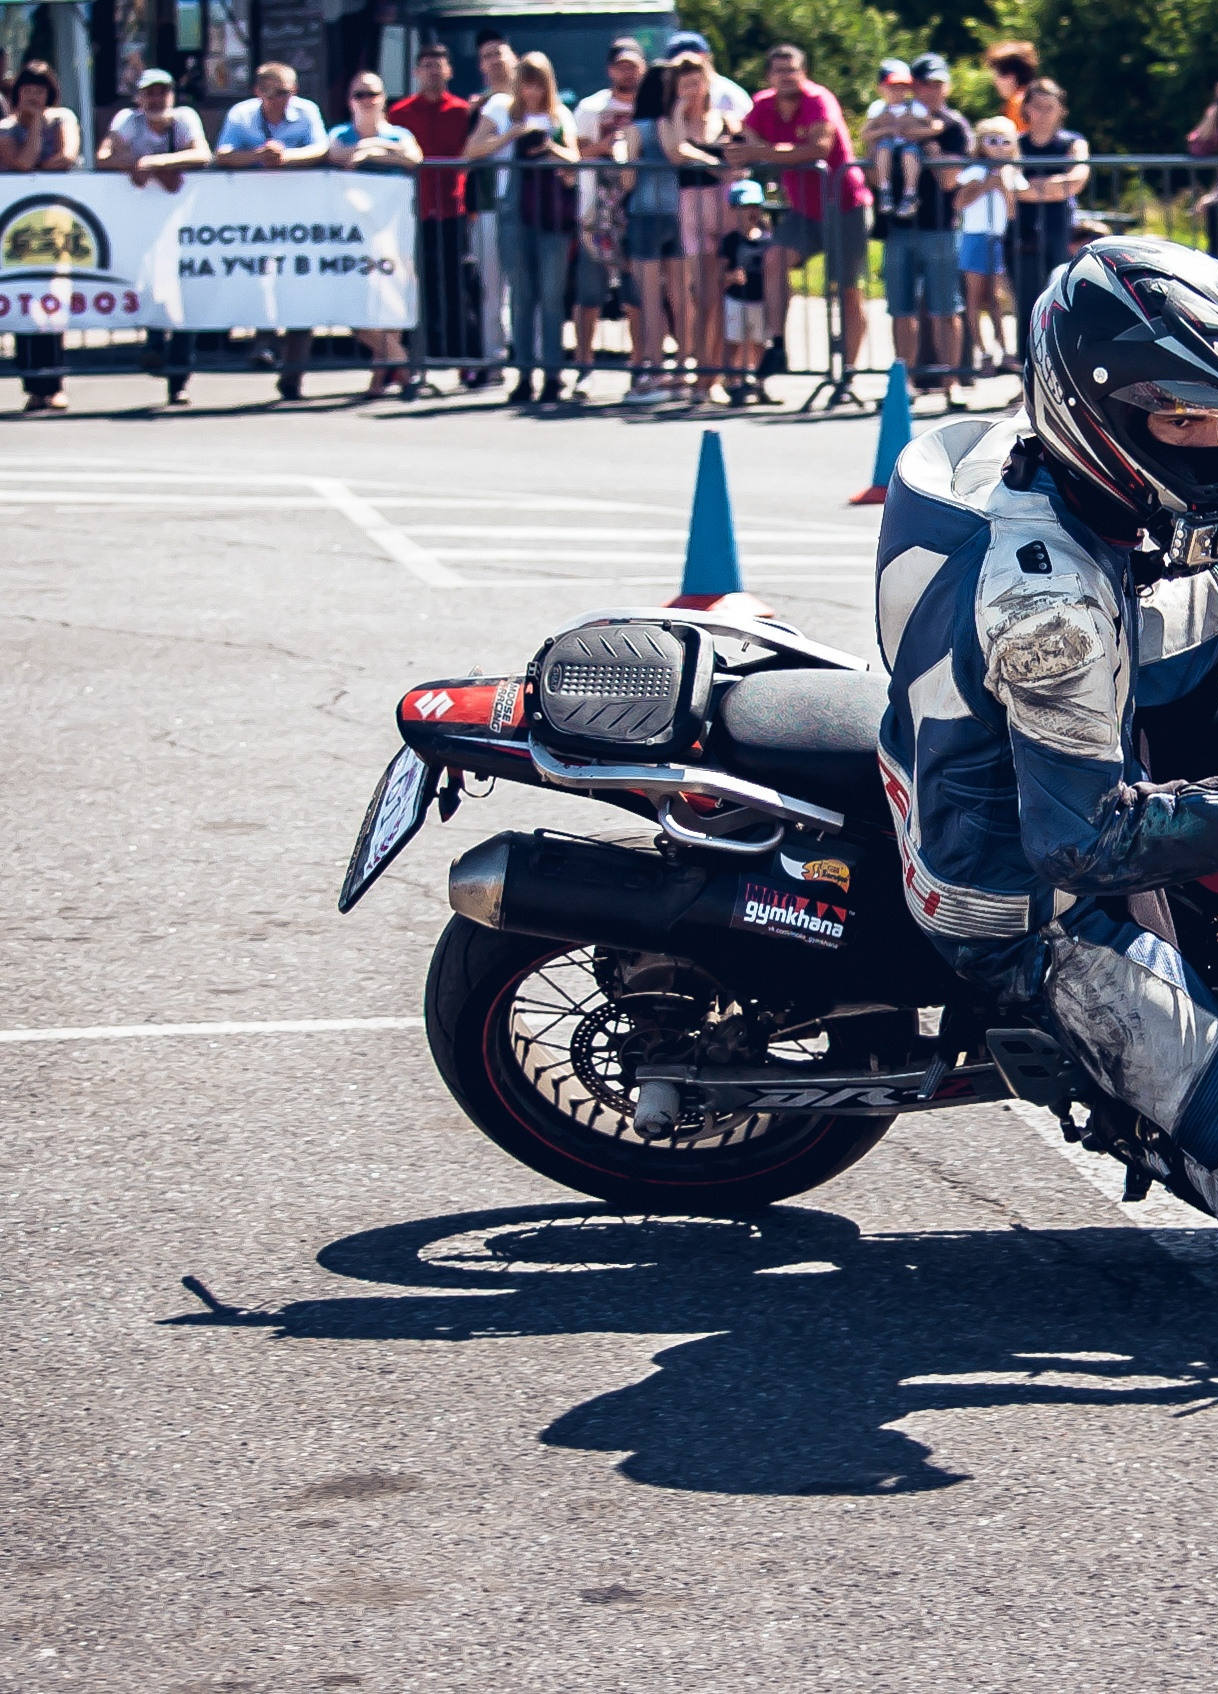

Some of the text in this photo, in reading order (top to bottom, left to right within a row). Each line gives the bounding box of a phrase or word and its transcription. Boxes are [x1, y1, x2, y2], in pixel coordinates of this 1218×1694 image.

[178, 223, 363, 245] ПОСТАНОВКА
[178, 256, 215, 277] НА
[294, 254, 311, 275] В
[491, 686, 509, 732] RACING
[501, 682, 520, 723] MOOSE
[743, 900, 844, 938] gymkhana
